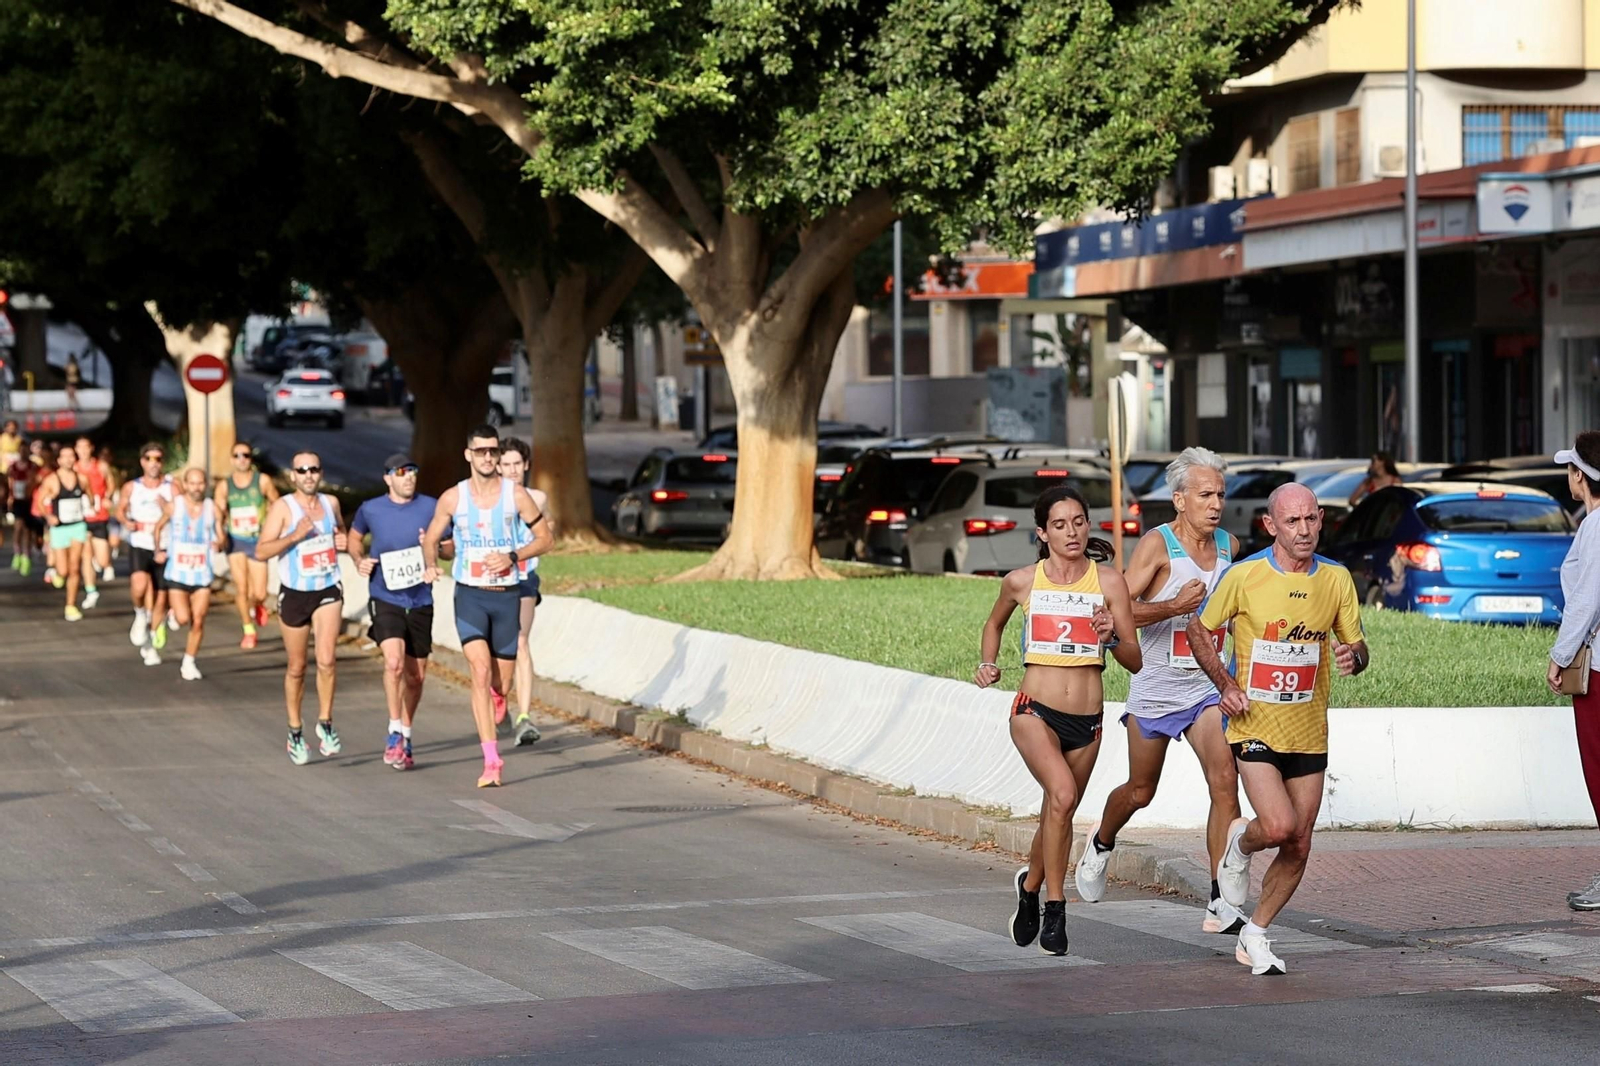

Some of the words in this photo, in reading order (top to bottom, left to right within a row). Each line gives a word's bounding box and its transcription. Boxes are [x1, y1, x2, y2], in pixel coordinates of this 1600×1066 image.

[388, 562, 421, 580] 7404
[1289, 590, 1308, 600] vive
[1056, 621, 1072, 642] 2
[1286, 621, 1327, 641] Álora
[1270, 671, 1298, 692] 39
